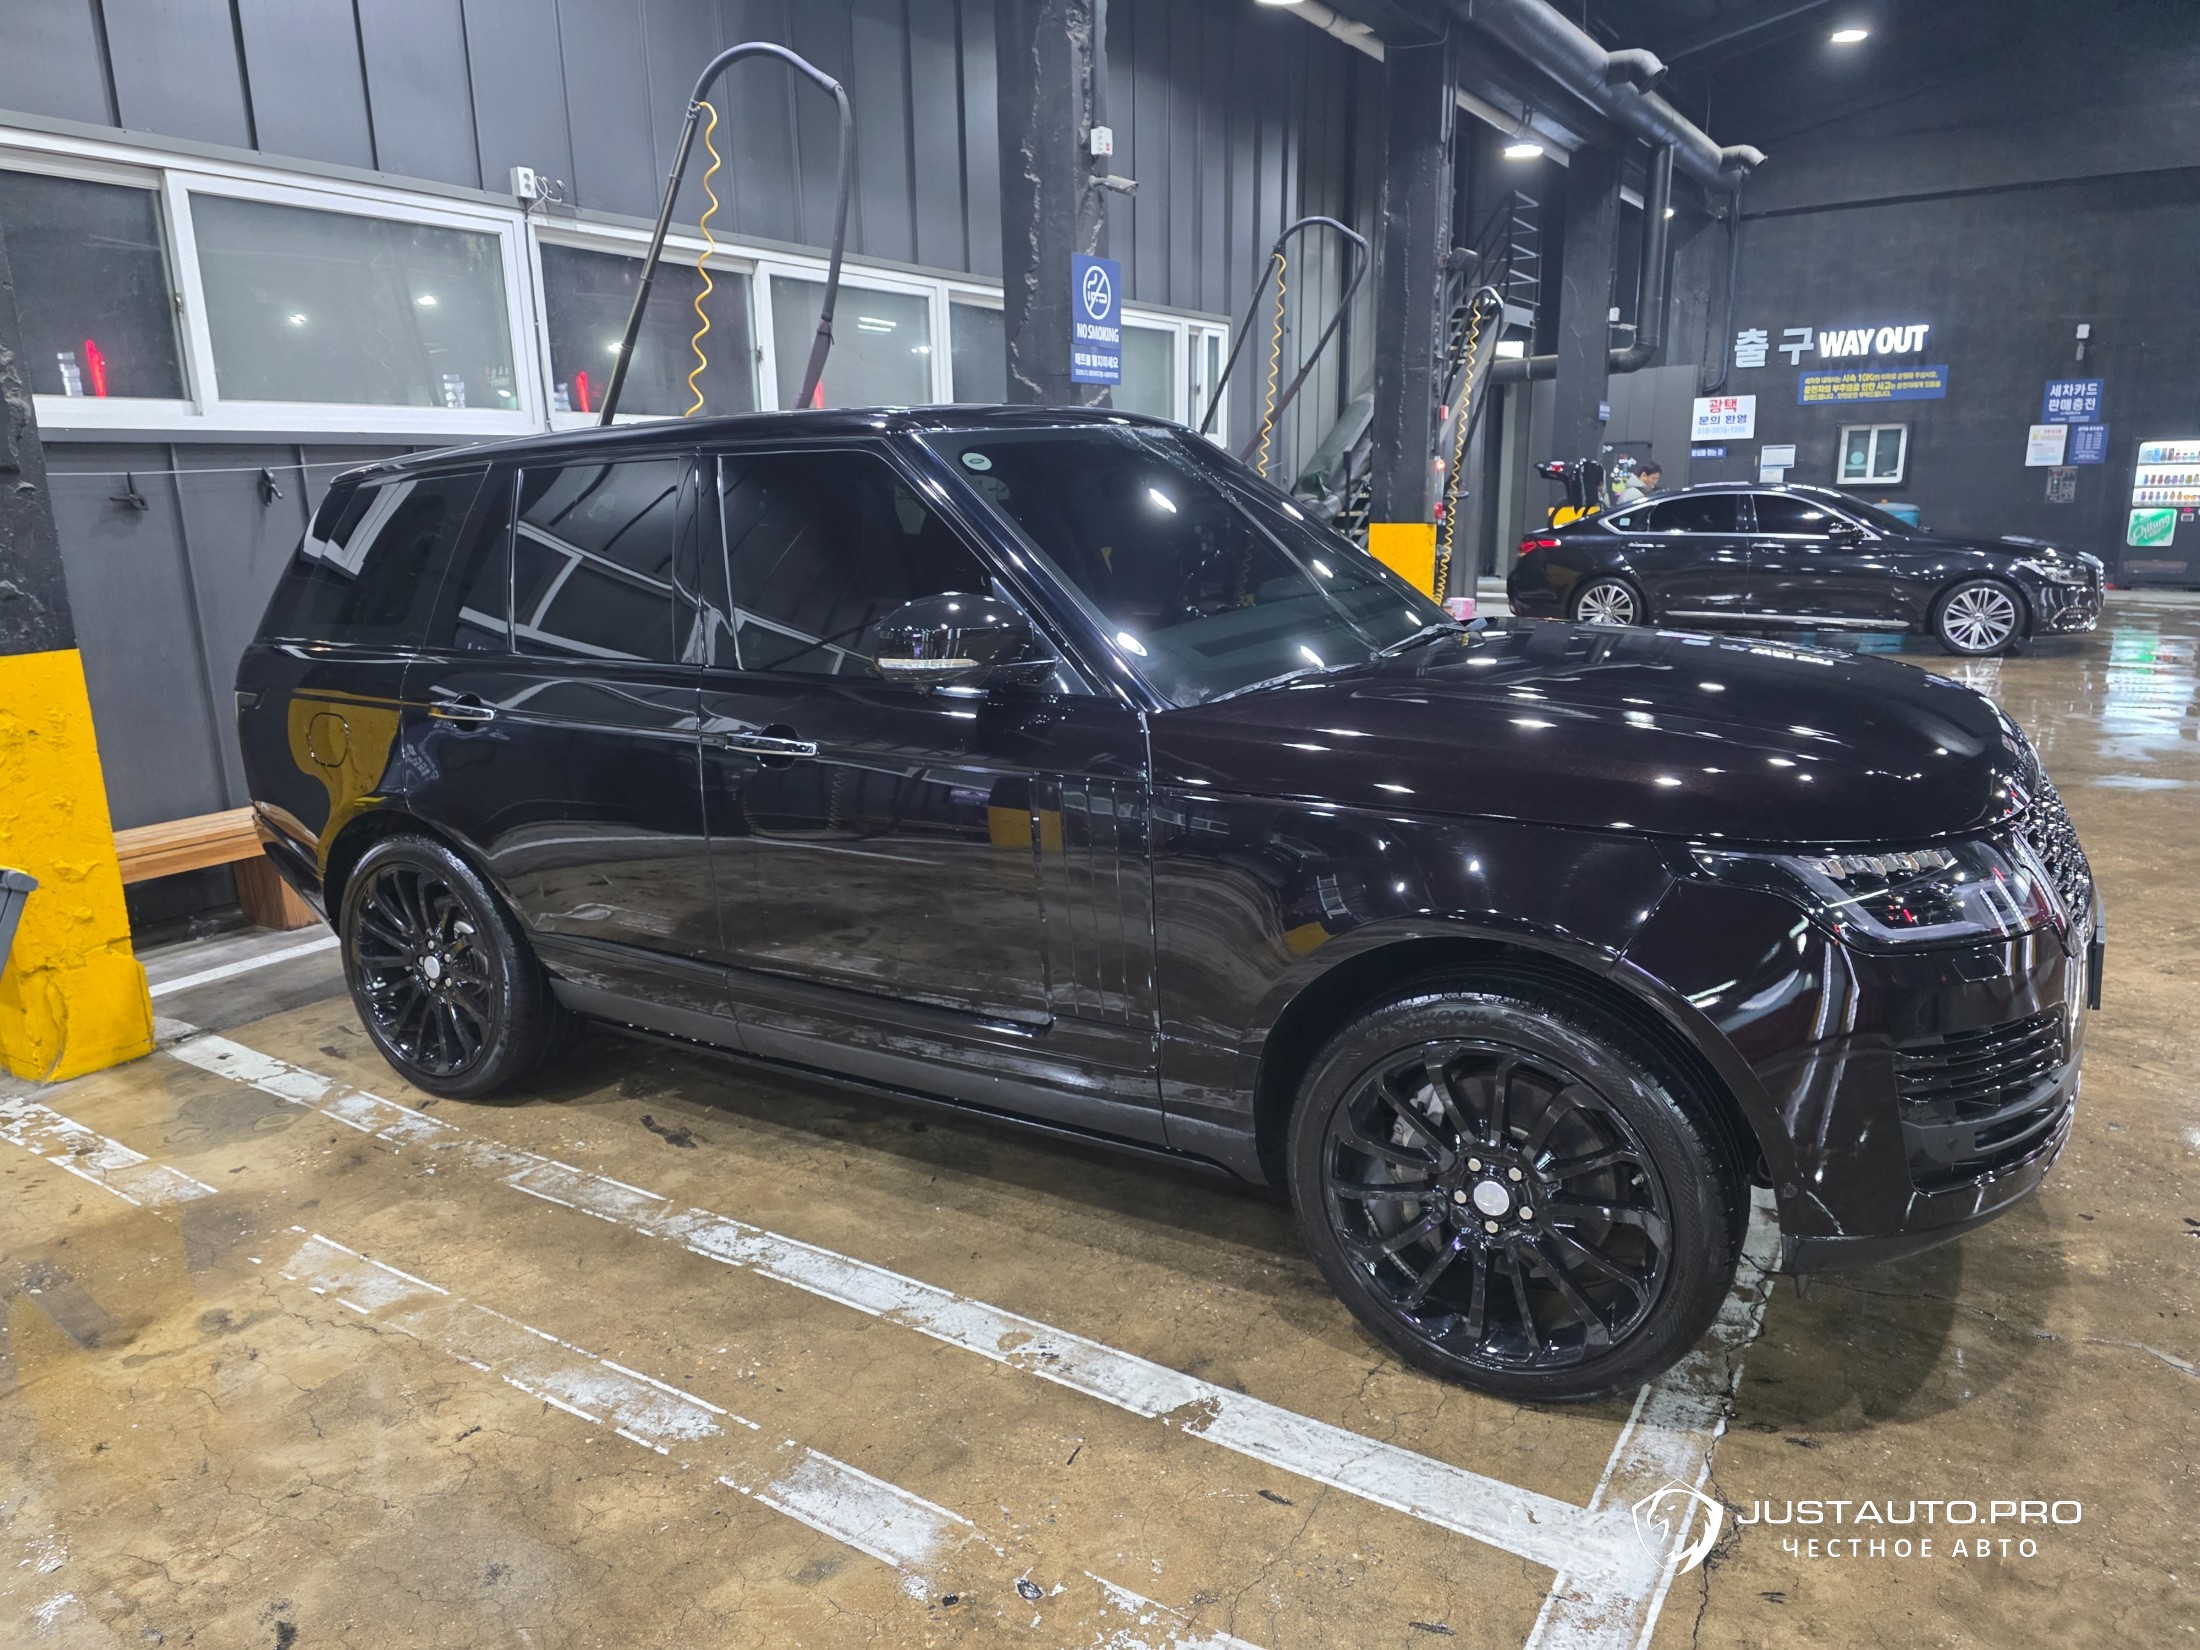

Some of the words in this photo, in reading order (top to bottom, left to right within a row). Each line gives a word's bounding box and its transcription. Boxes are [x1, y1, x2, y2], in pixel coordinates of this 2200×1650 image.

[1077, 322, 1087, 339] NO
[1088, 324, 1119, 343] SMOKING
[1819, 329, 1875, 358] WAY
[1876, 324, 1930, 354] OUT
[2049, 383, 2098, 397] 세차카드
[1709, 398, 1737, 413] 광택
[2048, 397, 2096, 412] 판매충전
[1699, 415, 1720, 425] 문의
[1725, 414, 1747, 424] 환영
